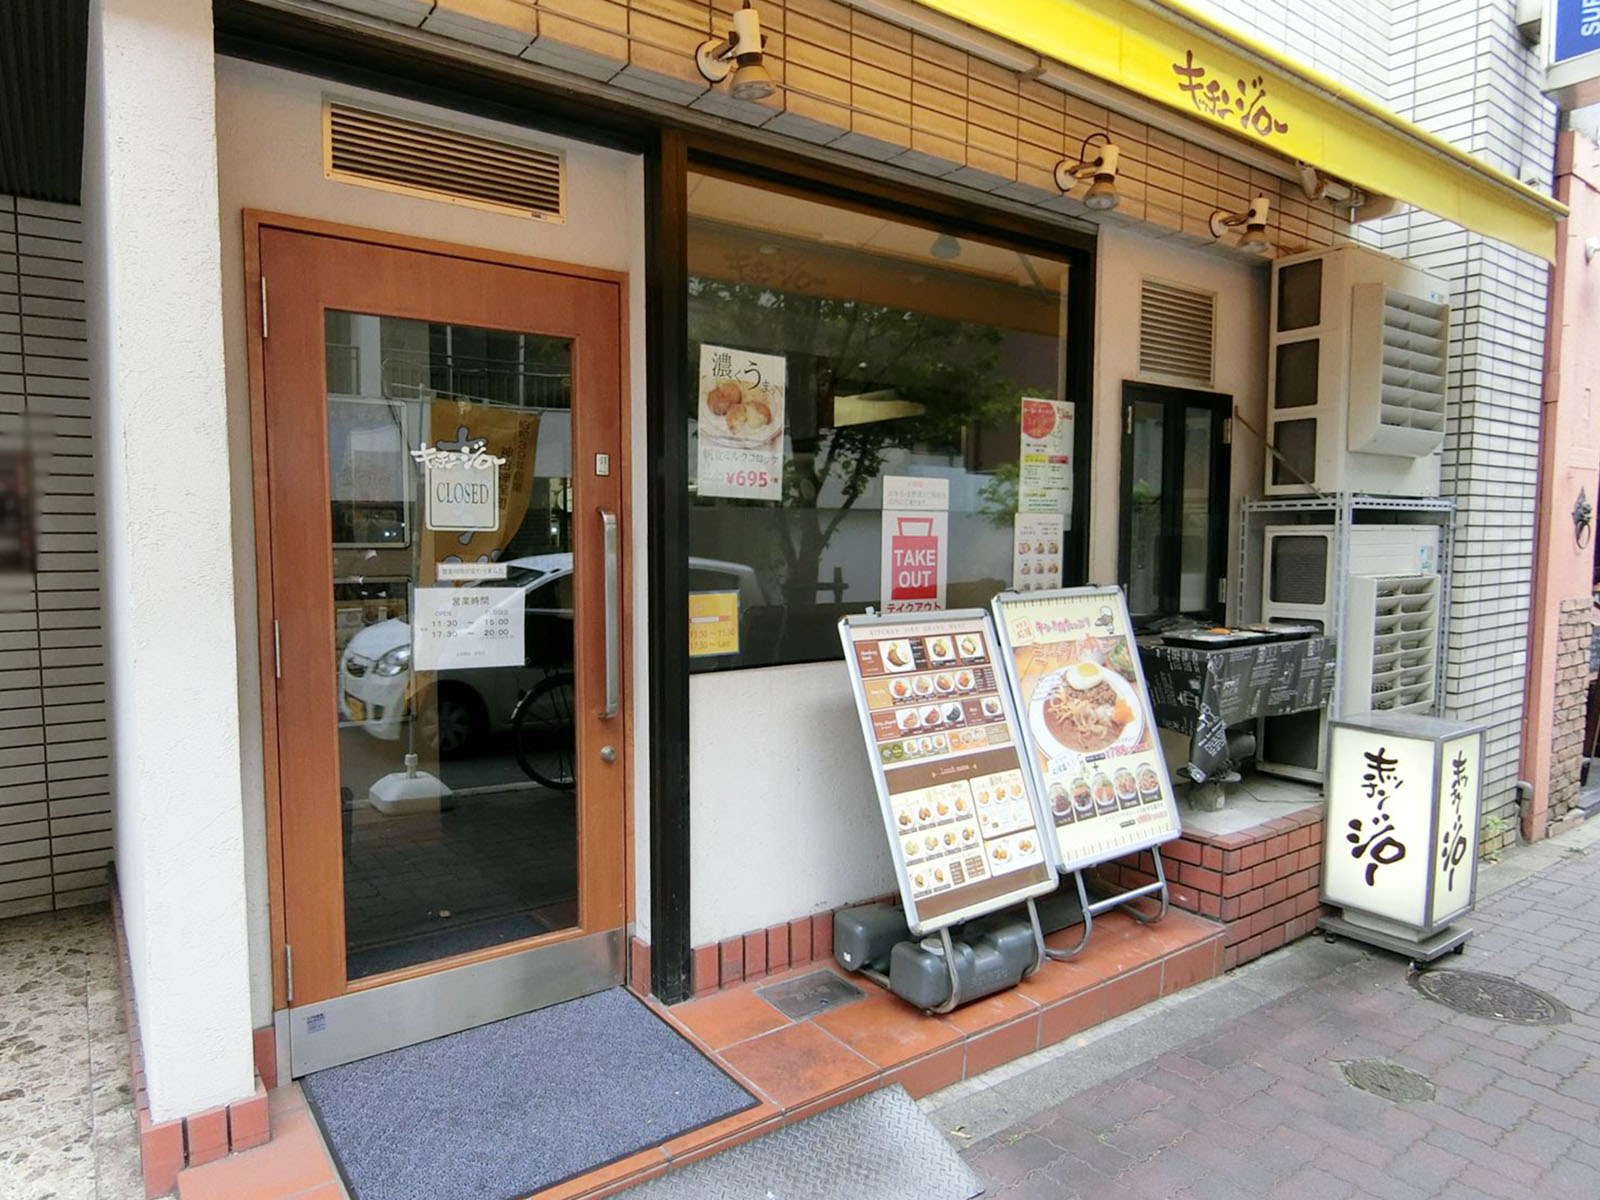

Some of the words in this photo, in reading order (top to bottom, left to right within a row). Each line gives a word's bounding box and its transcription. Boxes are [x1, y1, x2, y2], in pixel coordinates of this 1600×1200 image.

[436, 481, 489, 505] CLOSED
[893, 549, 937, 567] TAKE
[898, 570, 932, 588] OUT
[886, 602, 942, 614] テイクアウト
